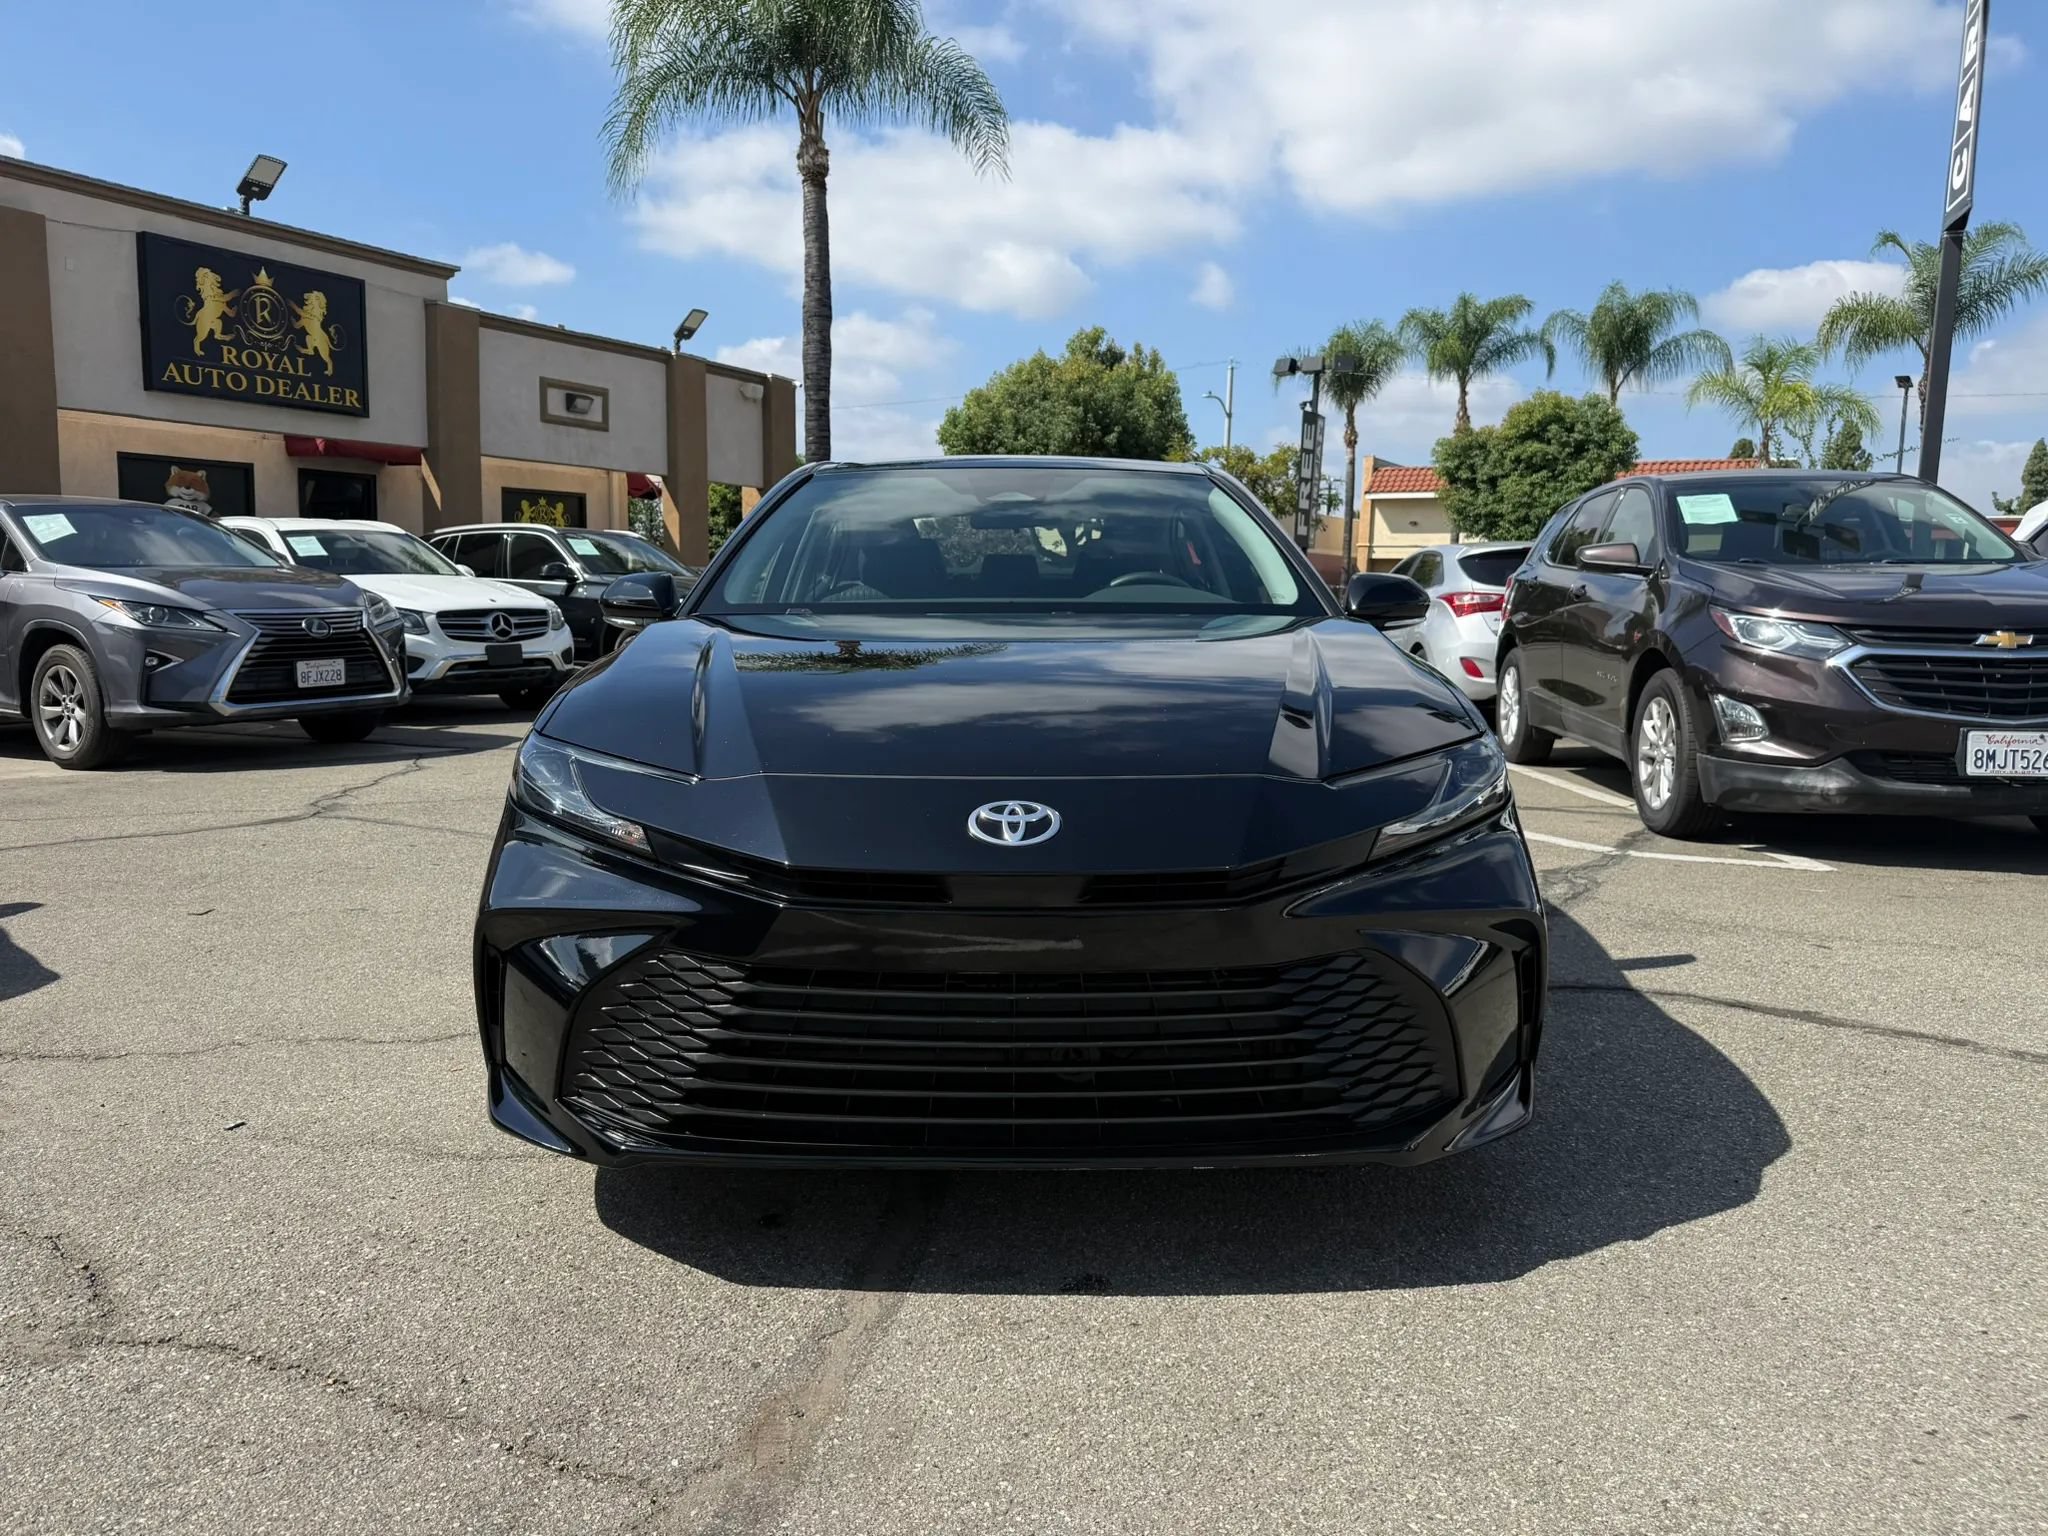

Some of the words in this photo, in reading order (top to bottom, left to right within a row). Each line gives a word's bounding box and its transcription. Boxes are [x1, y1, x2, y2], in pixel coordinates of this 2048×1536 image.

[1952, 0, 1979, 190] CAR
[255, 296, 272, 324] R
[220, 345, 312, 377] ROYAL
[161, 362, 248, 392] AUTO
[254, 375, 361, 408] DEALER
[1297, 423, 1314, 535] FREE
[300, 669, 342, 684] 8FJX228
[1986, 734, 2042, 747] California
